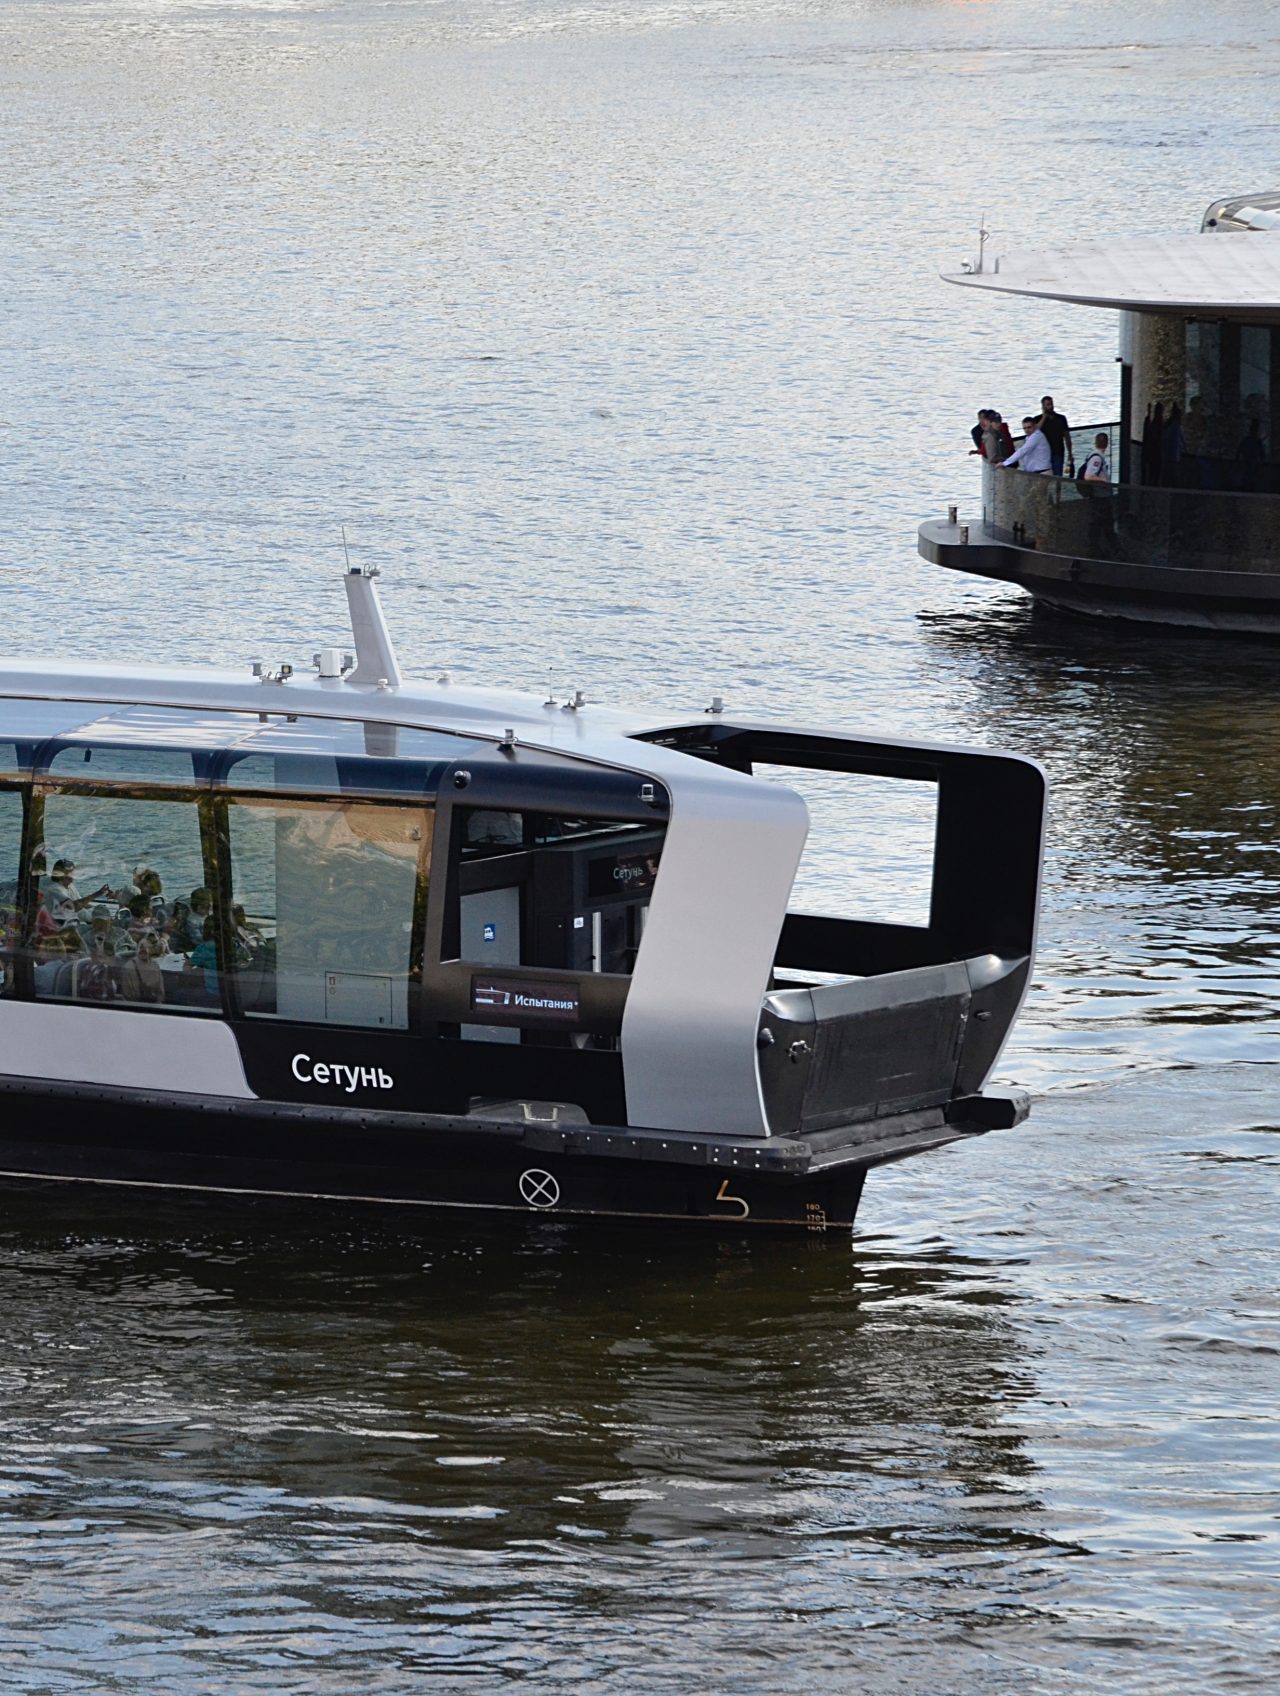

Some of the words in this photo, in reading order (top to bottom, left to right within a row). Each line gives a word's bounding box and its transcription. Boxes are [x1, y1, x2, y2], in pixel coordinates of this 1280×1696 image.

[613, 866, 644, 880] Сетунь
[514, 994, 574, 1010] Испытания
[291, 1053, 394, 1093] Сетунь
